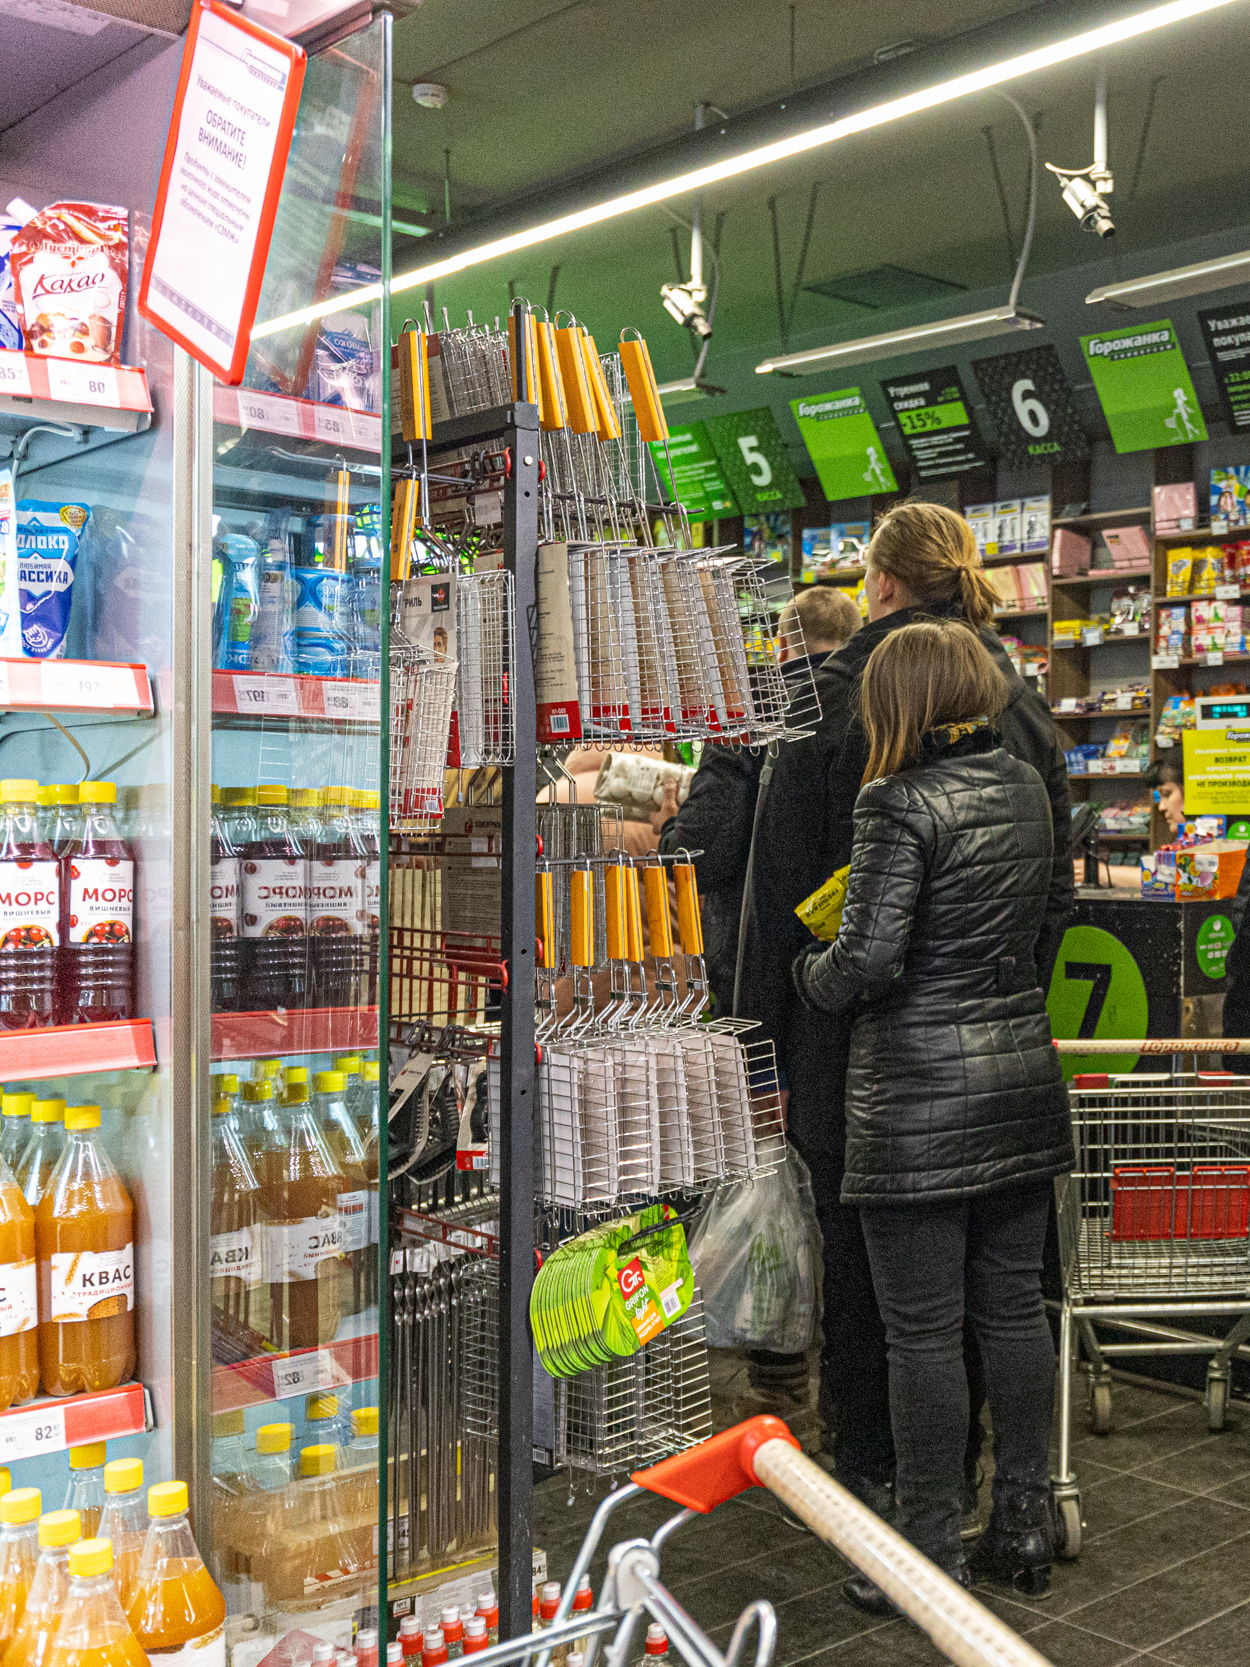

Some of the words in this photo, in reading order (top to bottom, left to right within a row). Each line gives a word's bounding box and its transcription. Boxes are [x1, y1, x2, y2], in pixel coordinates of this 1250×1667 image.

[196, 74, 232, 106] Уважаемые
[233, 99, 271, 129] покупатели
[206, 109, 246, 146] ОБРАТИТЕ
[198, 127, 247, 170] ВНИМАНИЕ!
[220, 193, 251, 220] отмечены
[42, 240, 101, 257] Густр
[33, 273, 105, 295] Какао
[1088, 330, 1170, 356] Горожанка
[89, 380, 105, 393] 80
[798, 396, 861, 417] Горожанка
[1011, 378, 1049, 437] 6
[901, 410, 942, 430] -15%
[1028, 442, 1061, 455] КАССА
[737, 435, 772, 487] 5
[17, 535, 69, 549] ОЛОКО
[19, 562, 52, 570] ЛЮБИМАЯ
[20, 569, 69, 585] АССИКА
[78, 680, 99, 693] 197
[1214, 756, 1247, 764] ВОЗВРАТ
[0, 891, 55, 907] МОРС
[82, 888, 133, 903] МОРС
[3, 908, 51, 916] ВИШНЕВЫЙ
[1065, 961, 1112, 1039] 7
[82, 1265, 131, 1288] КВАС
[625, 1285, 649, 1311] GRIFON
[35, 1425, 53, 1441] 82
